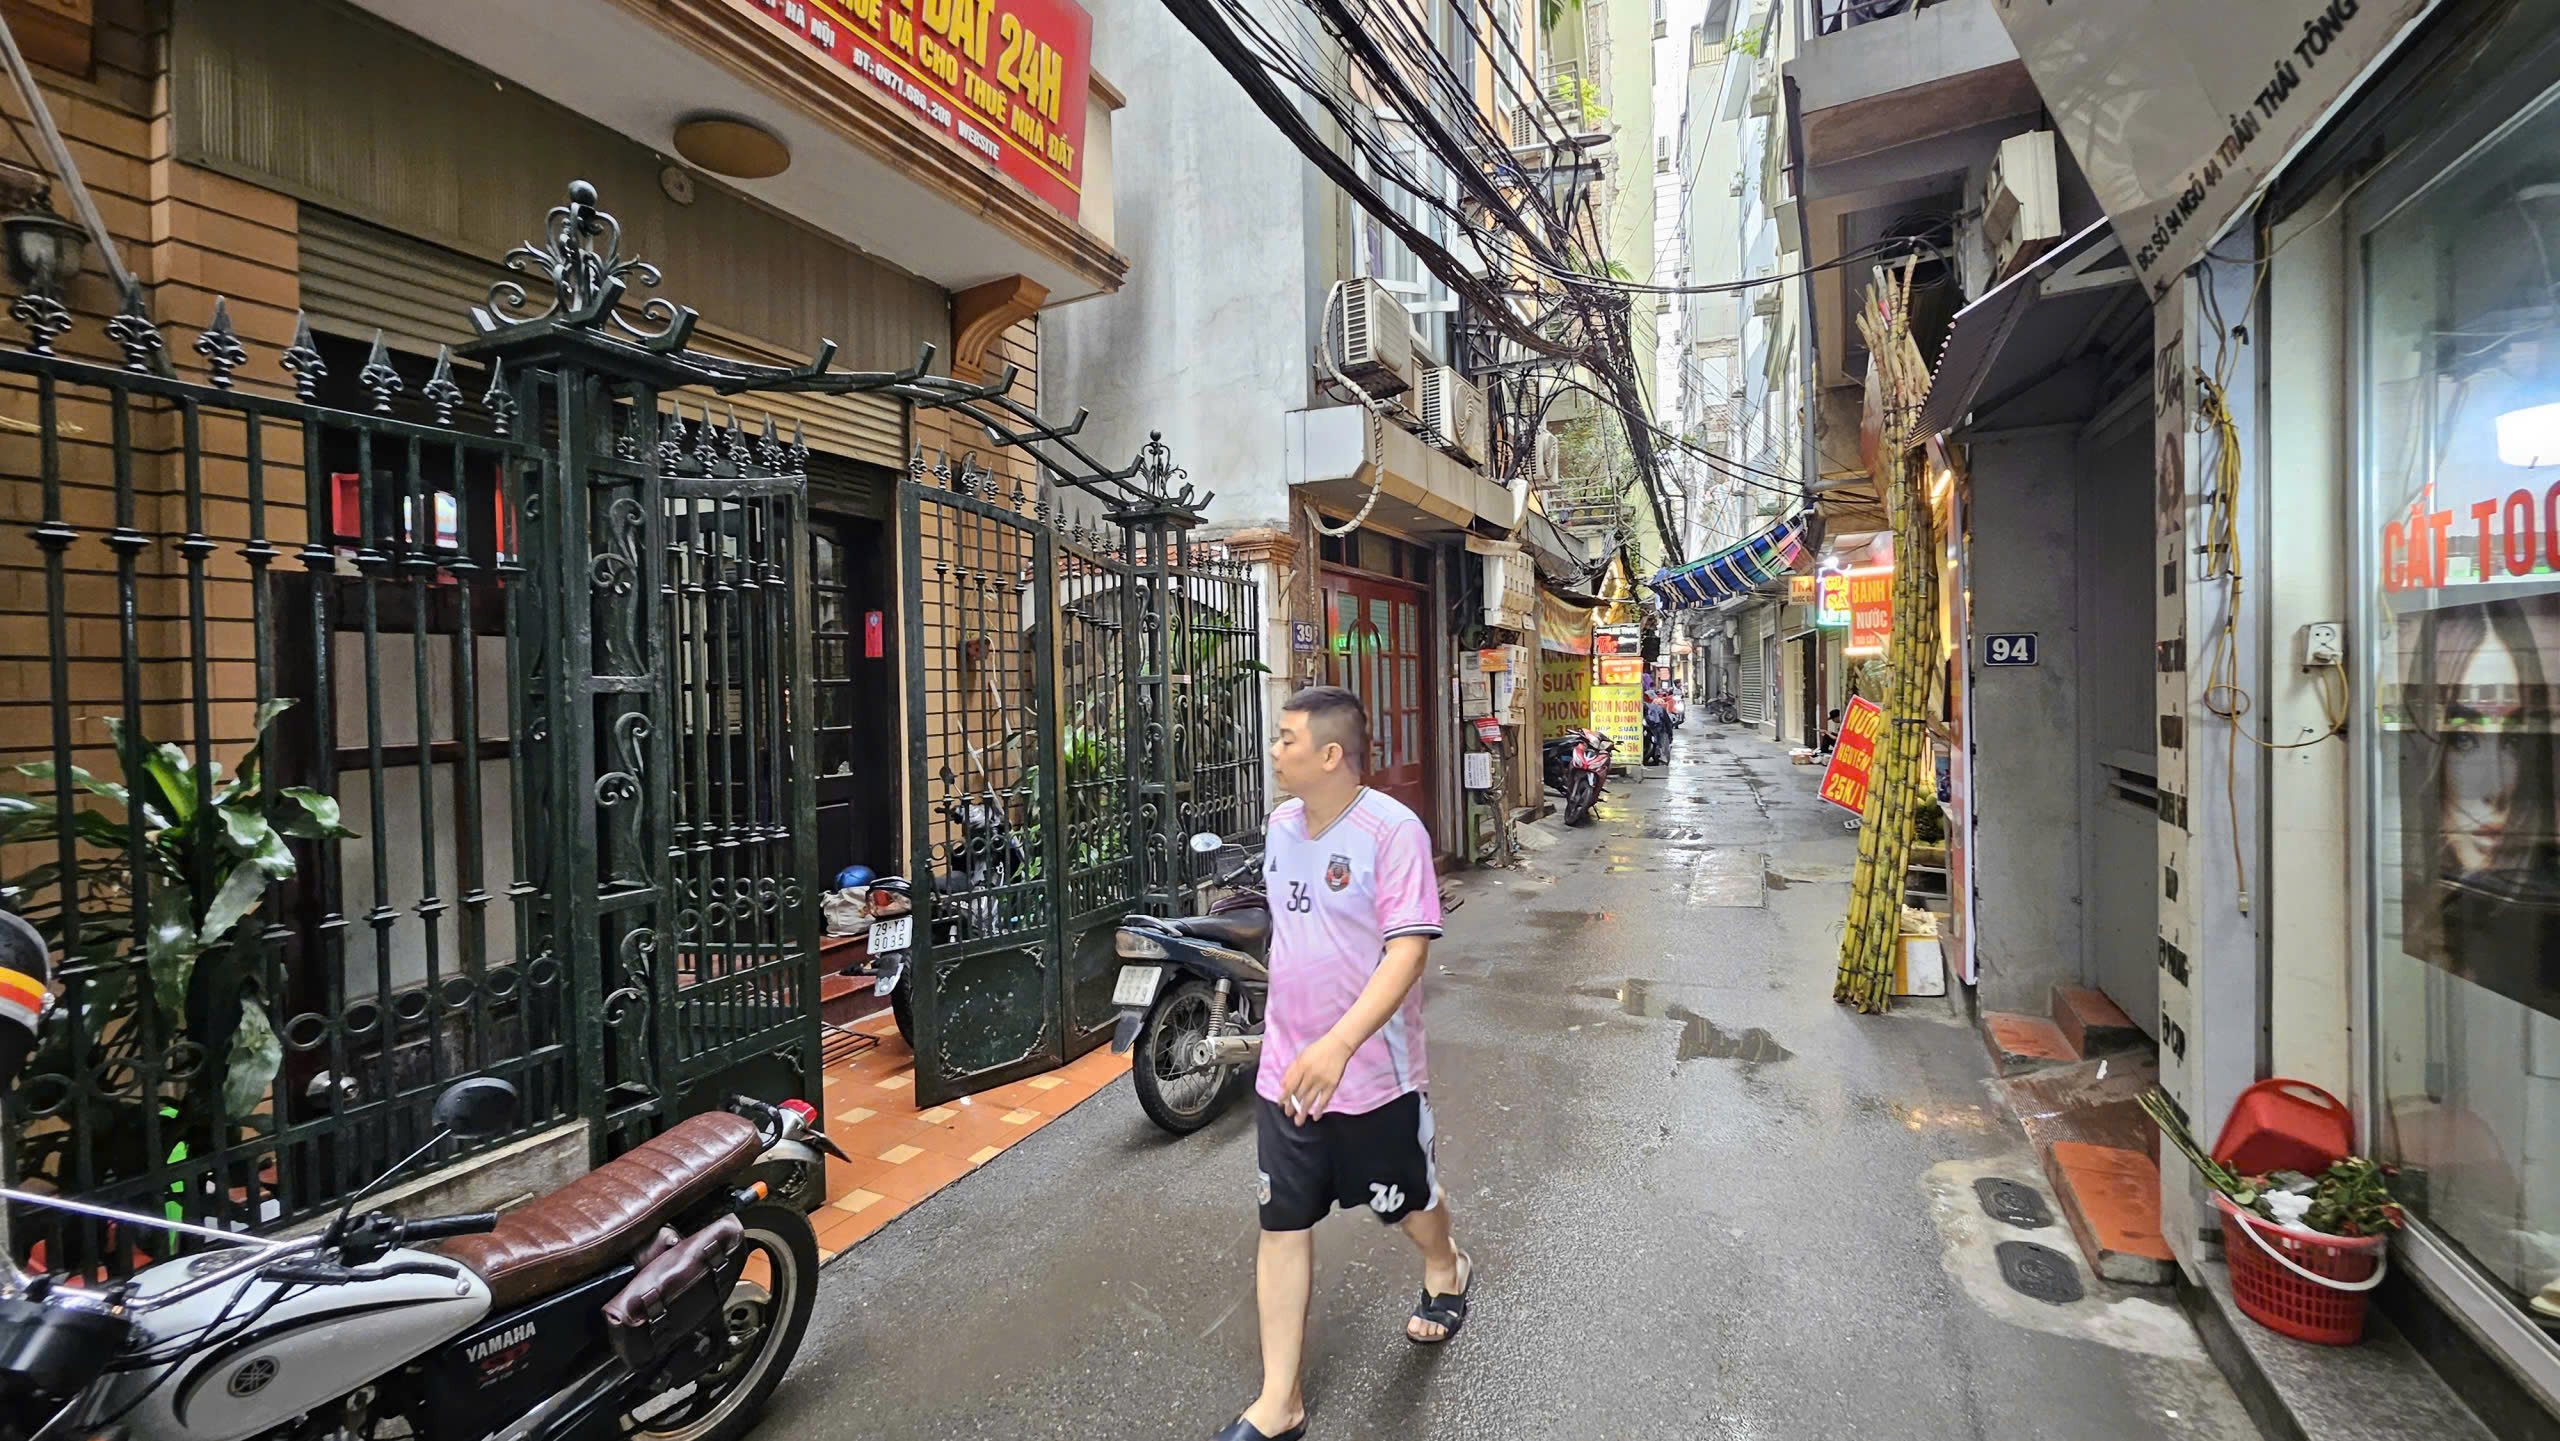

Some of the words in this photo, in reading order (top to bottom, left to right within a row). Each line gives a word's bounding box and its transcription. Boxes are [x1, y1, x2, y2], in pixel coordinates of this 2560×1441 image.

[811, 17, 835, 48] NỘI
[957, 119, 999, 160] WEBSITE
[890, 8, 913, 56] VÀ
[919, 34, 958, 86] CHO
[964, 67, 1008, 124] THUÊ
[1011, 104, 1045, 152] NHÀ
[997, 13, 1062, 124] 24H
[2253, 59, 2301, 119] THÁI
[2294, 0, 2359, 69] TÔNG
[2384, 483, 2452, 594] CẮT
[1992, 637, 2028, 661] 94
[1287, 881, 1312, 913] 36
[874, 933, 905, 951] 9035
[1369, 1182, 1405, 1213] 36
[465, 1321, 536, 1363] YAMAHA
